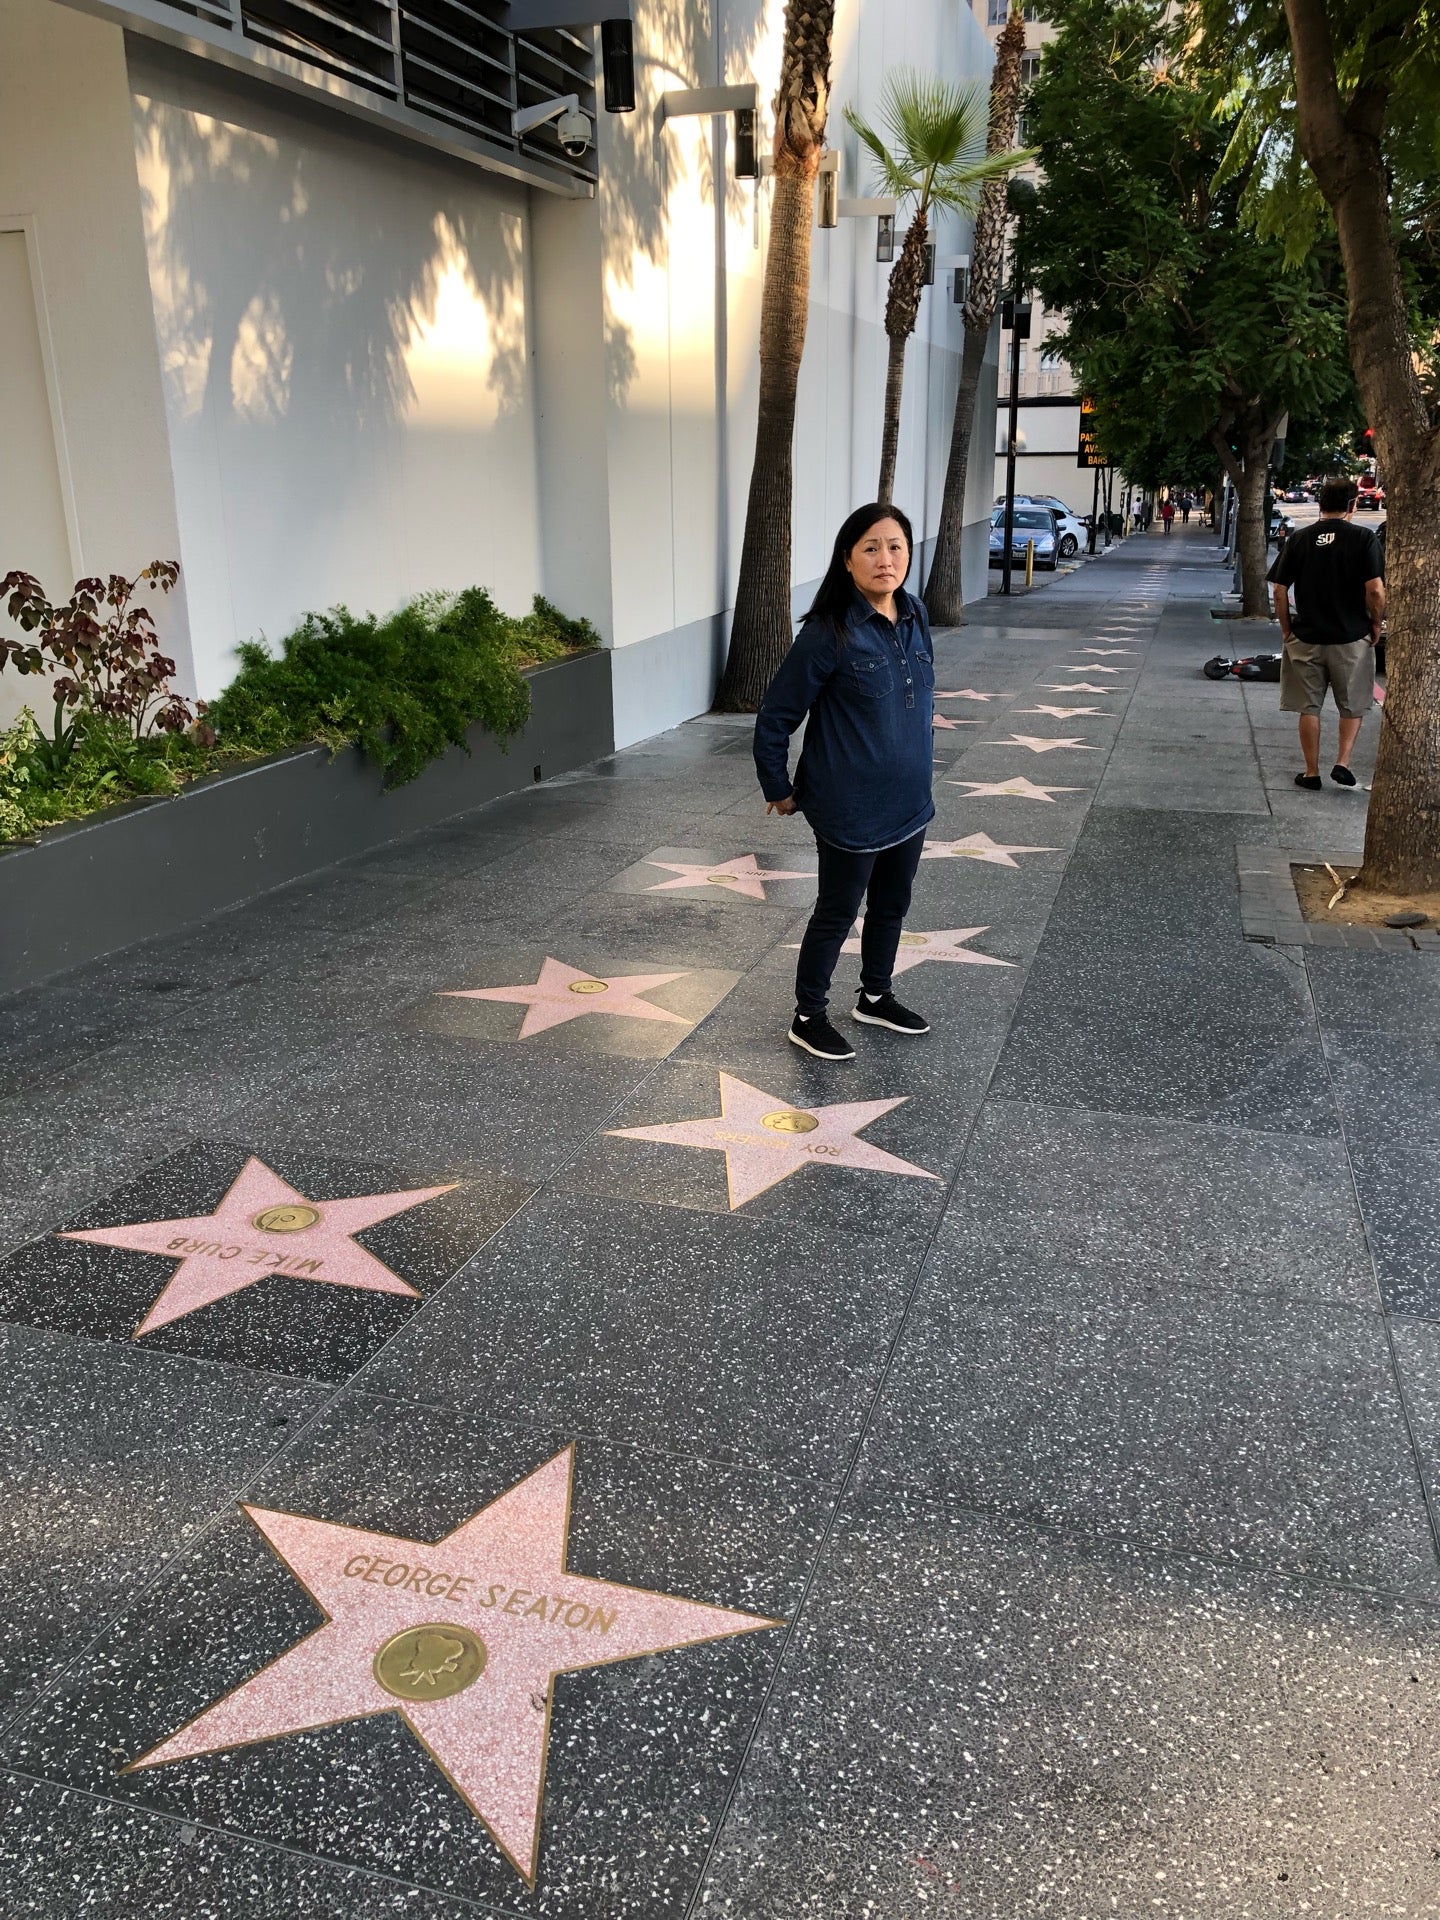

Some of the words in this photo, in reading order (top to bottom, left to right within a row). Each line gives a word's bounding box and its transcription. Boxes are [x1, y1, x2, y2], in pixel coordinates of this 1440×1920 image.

[798, 1144, 842, 1157] ROY
[166, 1237, 243, 1260] CURB
[247, 1250, 325, 1274] MIKE
[342, 1554, 475, 1603] GEORGE
[479, 1584, 618, 1633] SEATON
